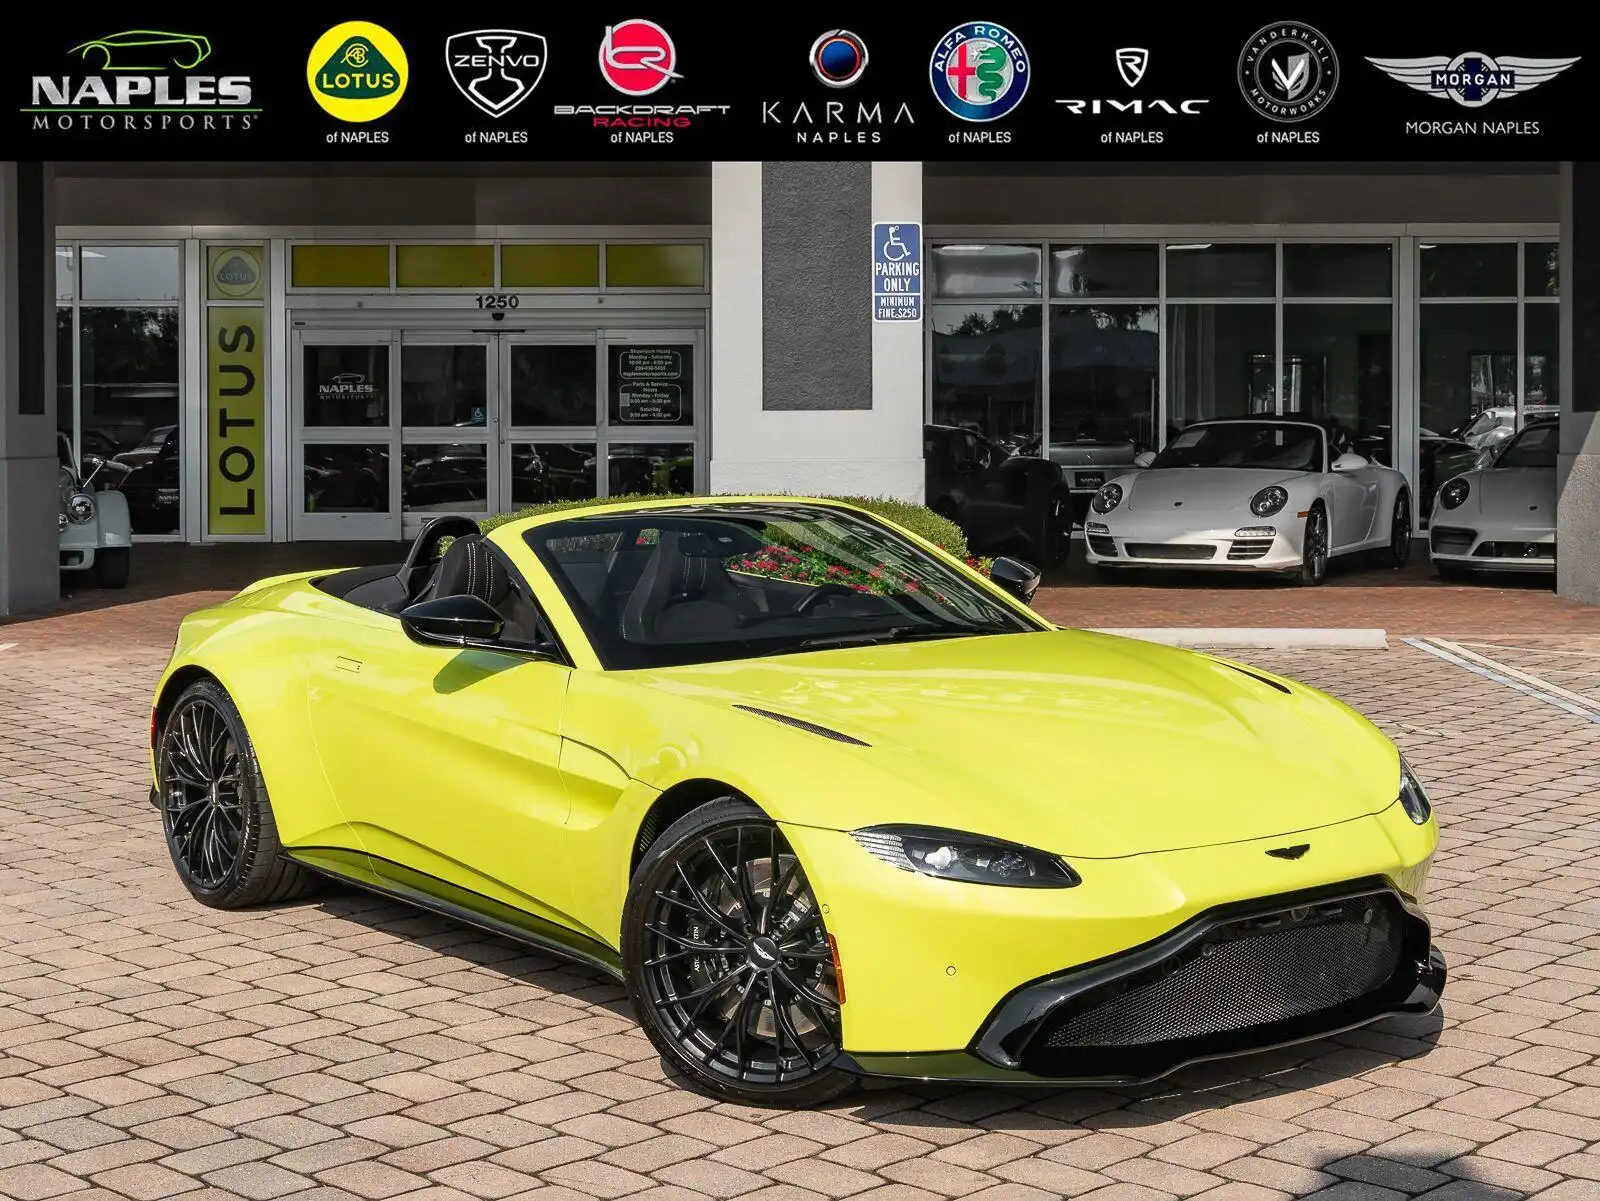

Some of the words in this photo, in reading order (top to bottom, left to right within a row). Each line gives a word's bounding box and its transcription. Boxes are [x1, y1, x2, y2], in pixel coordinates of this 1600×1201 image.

[875, 262, 920, 276] PARKING
[883, 278, 911, 292] ONLY
[475, 294, 520, 309] 1250
[880, 296, 915, 307] MINIMUM
[878, 308, 896, 318] FINE
[898, 308, 917, 319] $250
[319, 384, 373, 393] NAPLES
[218, 324, 256, 516] LOTUS
